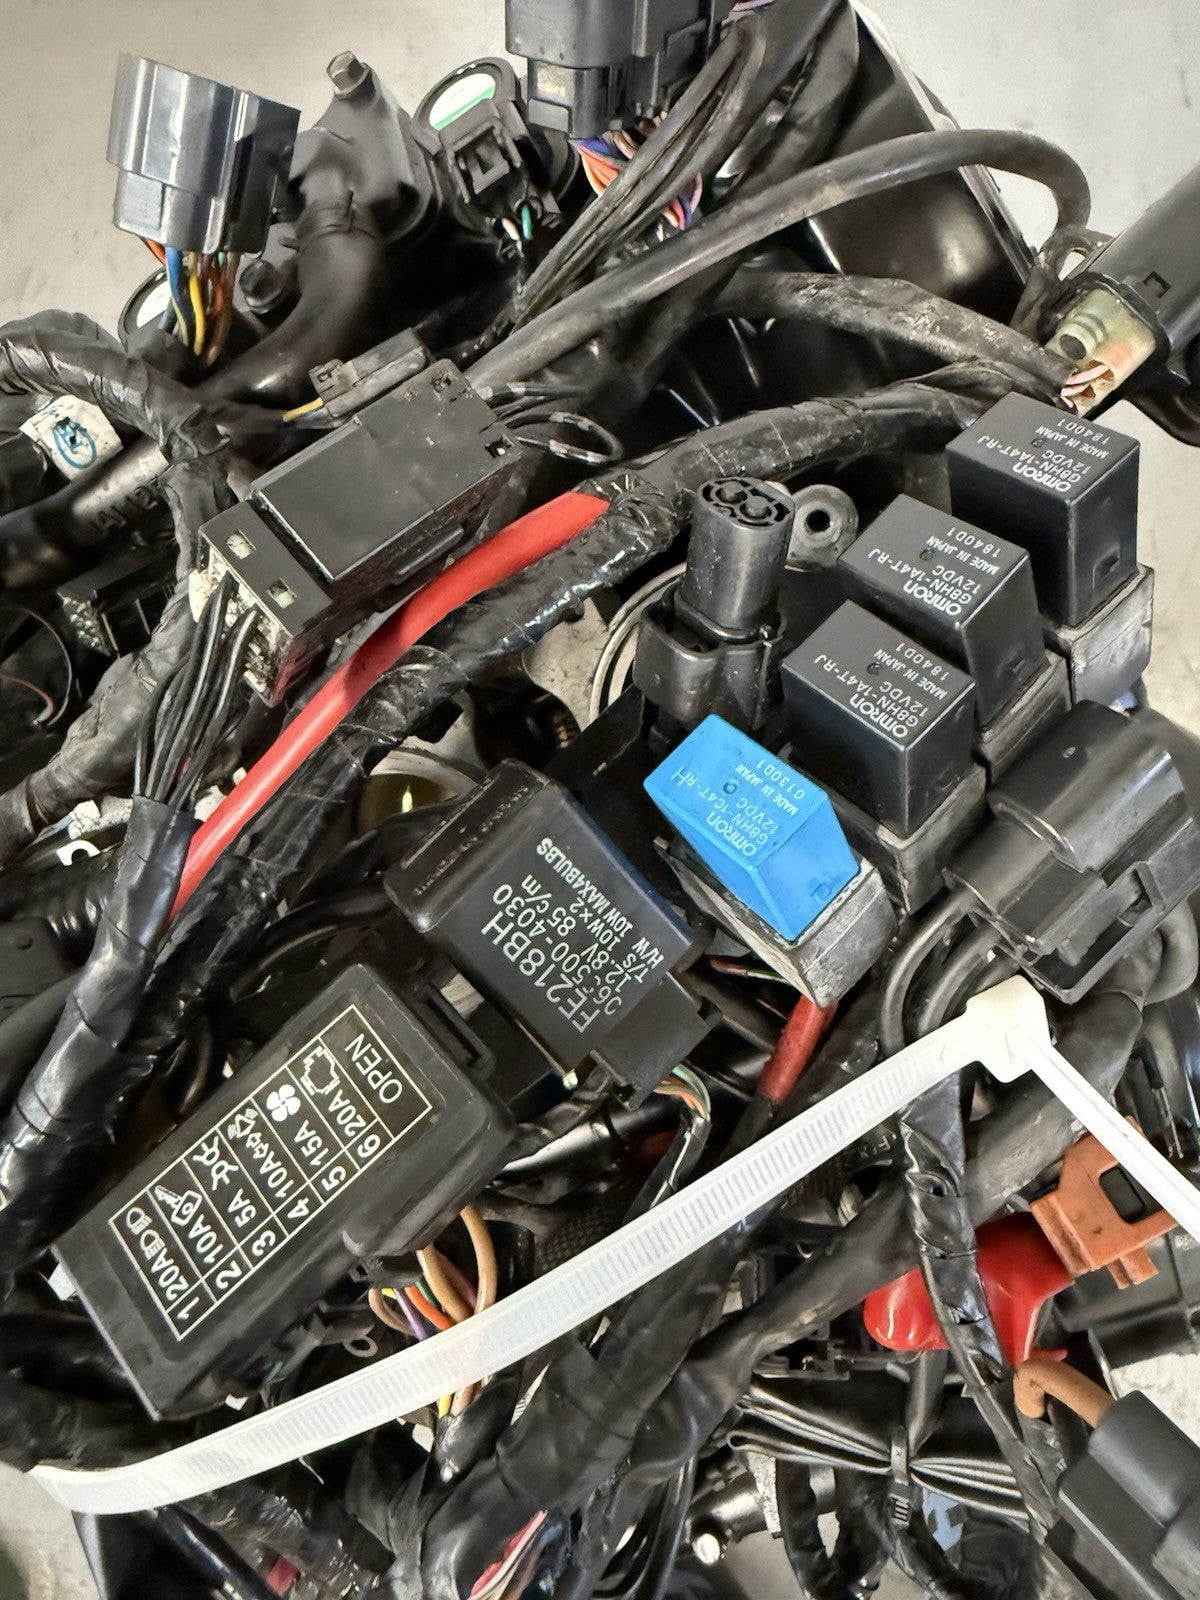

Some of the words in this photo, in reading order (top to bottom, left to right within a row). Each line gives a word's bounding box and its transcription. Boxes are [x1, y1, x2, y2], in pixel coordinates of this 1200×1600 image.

[1034, 425, 1068, 442] JAPAN
[1064, 437, 1081, 448] IN
[1041, 448, 1091, 474] 12VDC
[1078, 442, 1109, 459] MADE
[1011, 461, 1071, 492] omron
[925, 535, 958, 554] JAPAN
[955, 549, 971, 562] IN
[867, 547, 972, 604] G8HN-1A4T-RJ
[931, 564, 981, 594] 12VDC
[968, 555, 1000, 575] MADE
[902, 579, 962, 616] omron
[872, 648, 906, 671] JAPAN
[902, 667, 919, 681] IN
[813, 653, 919, 727] G8HN-1A4T-RJ
[878, 680, 928, 717] 12VDC
[915, 676, 948, 700] MADE
[848, 692, 908, 738] omron
[734, 763, 763, 786] JAPAN
[760, 783, 775, 796] IN
[670, 767, 768, 850] G8HN-1C4T-RH
[735, 796, 779, 834] 12VDC
[771, 792, 799, 816] MADE
[705, 810, 757, 856] omron
[601, 906, 633, 938] 10W
[579, 941, 632, 993] 12.8V
[621, 952, 649, 984] T/S
[631, 936, 664, 969] H/W
[480, 909, 600, 1033] FE218BH
[343, 1032, 403, 1104] OPEN
[327, 1088, 366, 1137] 20A
[293, 1118, 329, 1166] 15A
[356, 1133, 381, 1158] 6
[258, 1149, 294, 1198] 10A
[320, 1165, 346, 1191] 5
[227, 1187, 256, 1228] 5A
[286, 1196, 309, 1219] 4
[187, 1212, 224, 1264] 10A
[251, 1229, 276, 1256] 3
[150, 1247, 190, 1301] 20A
[215, 1259, 243, 1289] 2
[176, 1295, 200, 1319] 1
